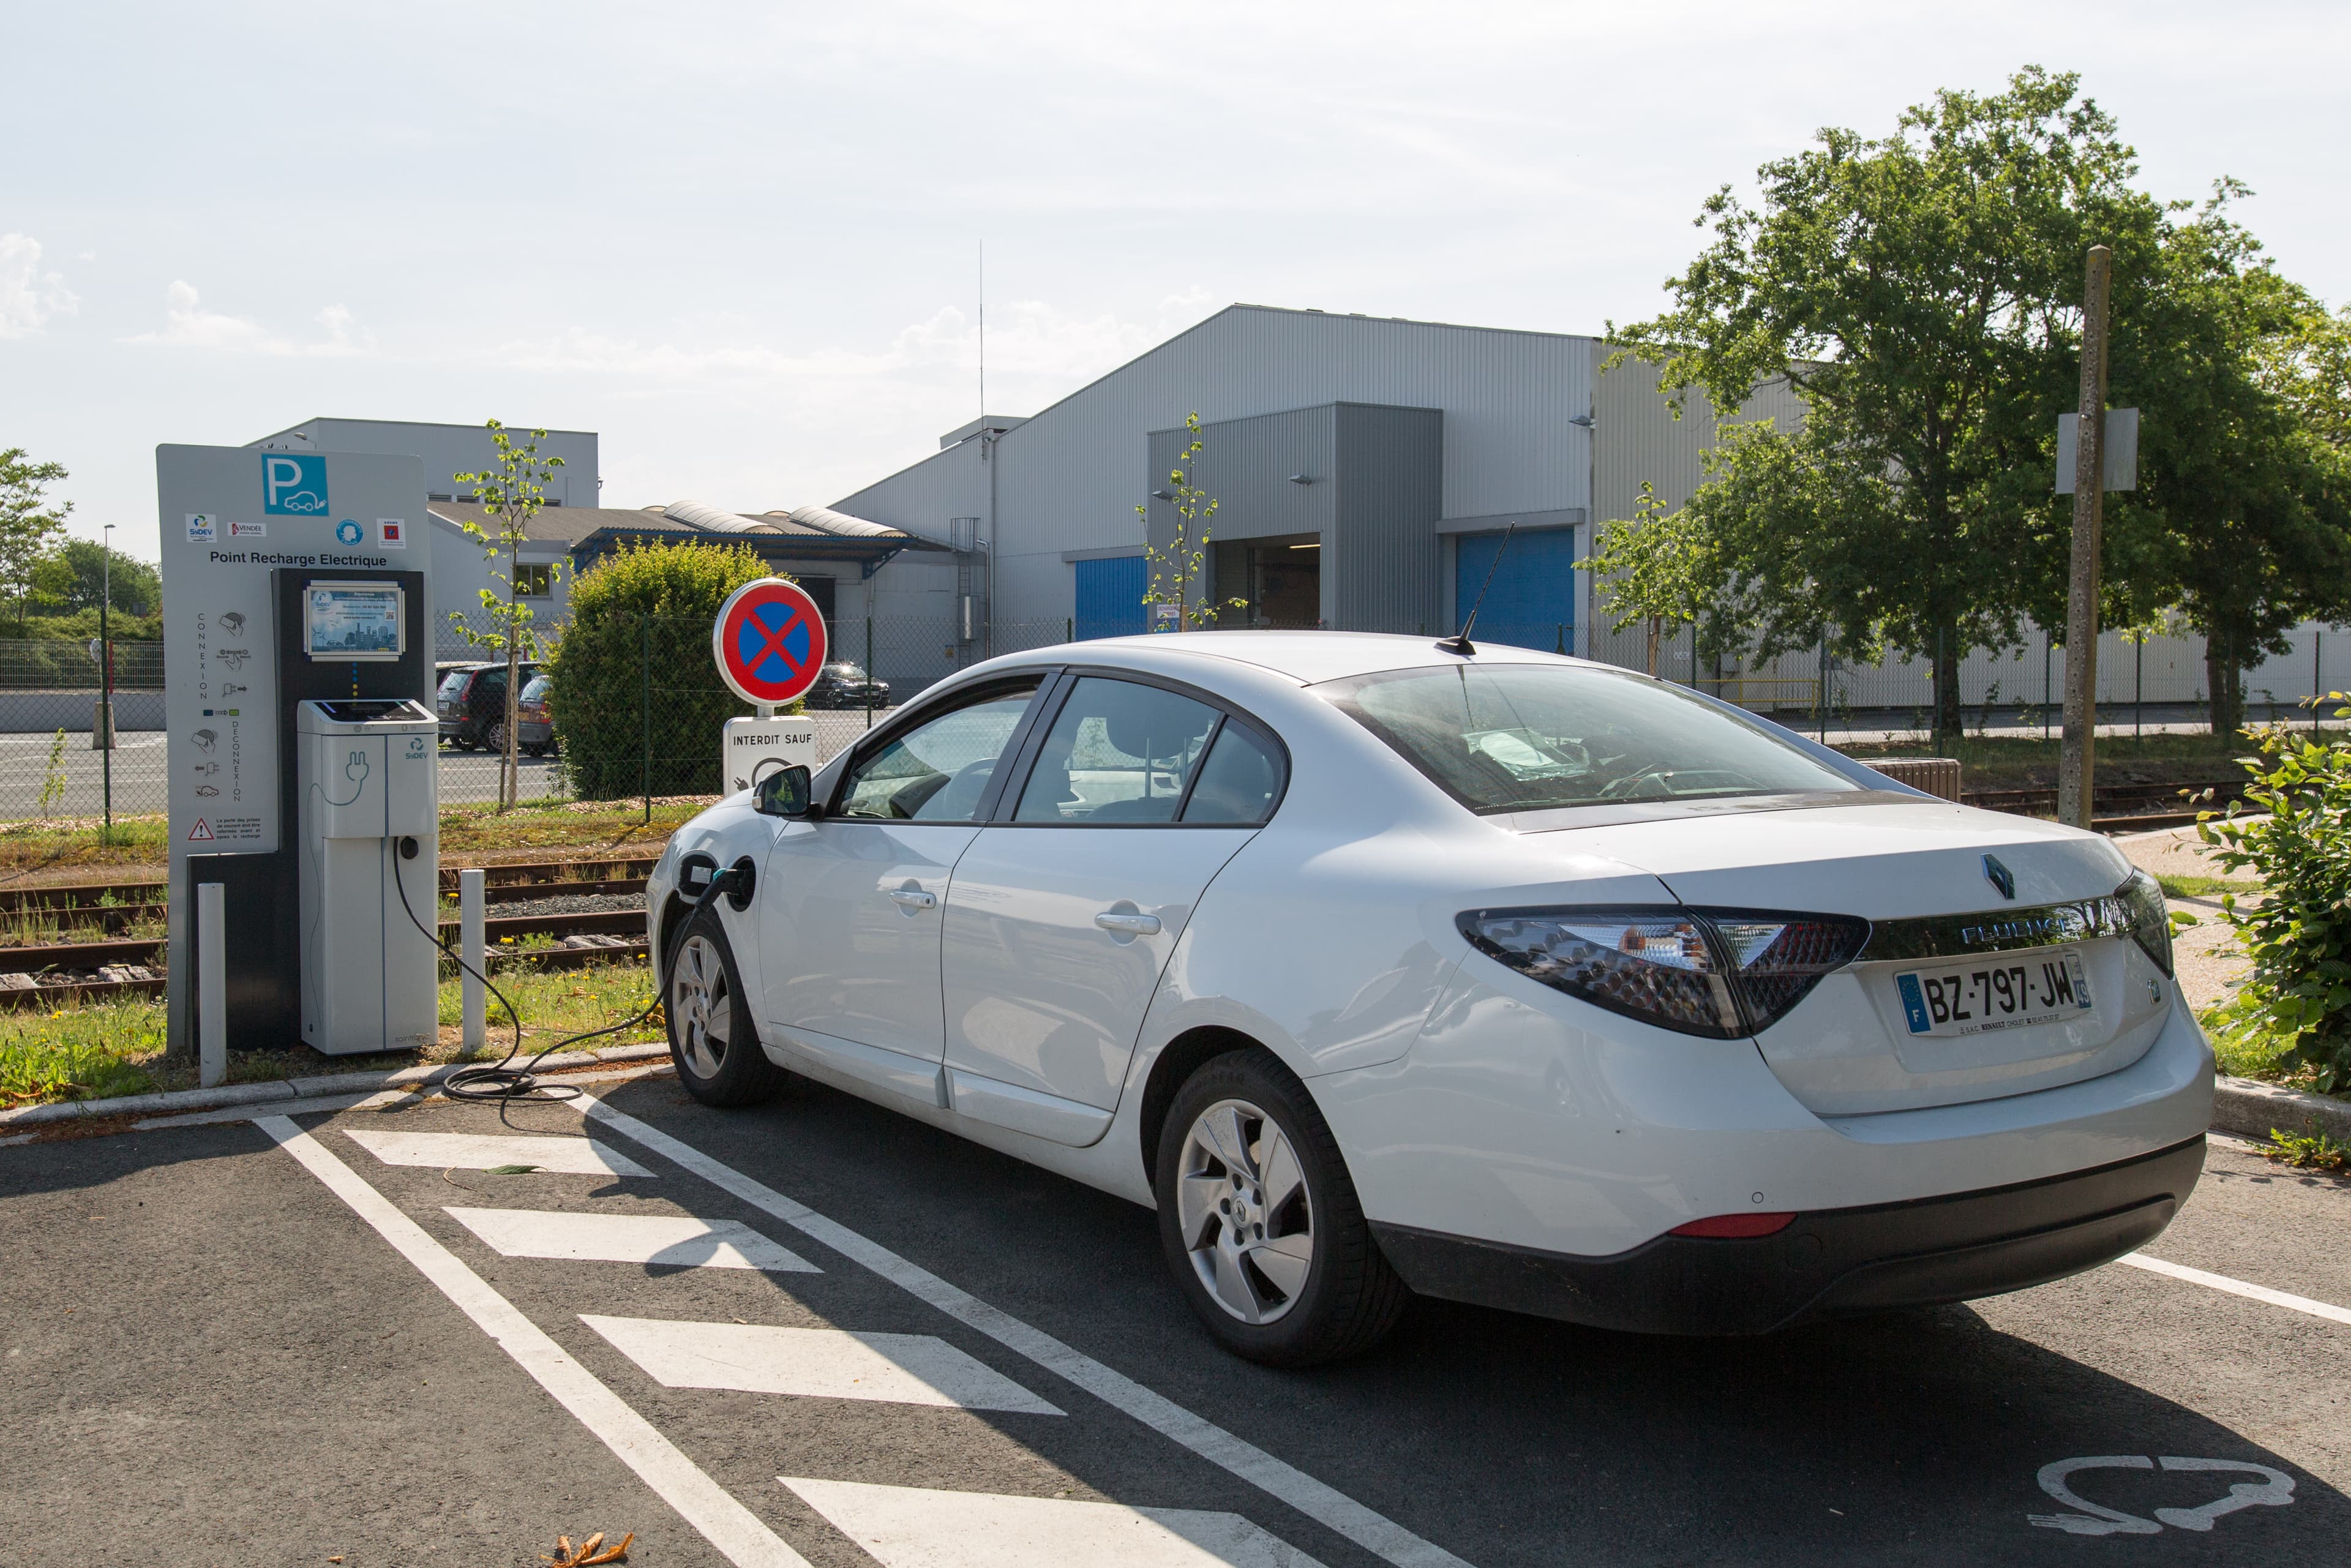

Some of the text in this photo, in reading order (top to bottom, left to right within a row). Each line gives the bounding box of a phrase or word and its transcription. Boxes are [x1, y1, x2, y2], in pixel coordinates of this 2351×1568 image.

[267, 458, 302, 505] P
[210, 551, 387, 568] Point Recharge Electrique
[198, 613, 208, 699] CONNEXION
[733, 733, 812, 746] INTERDIT SAUF
[232, 721, 241, 803] DECONNEXION
[1962, 918, 2070, 944] FLUENCE
[1912, 1009, 1920, 1022] F
[2076, 983, 2090, 1003] 49
[1980, 1021, 2006, 1030] RENAULT
[2007, 1018, 2025, 1027] CHOLET
